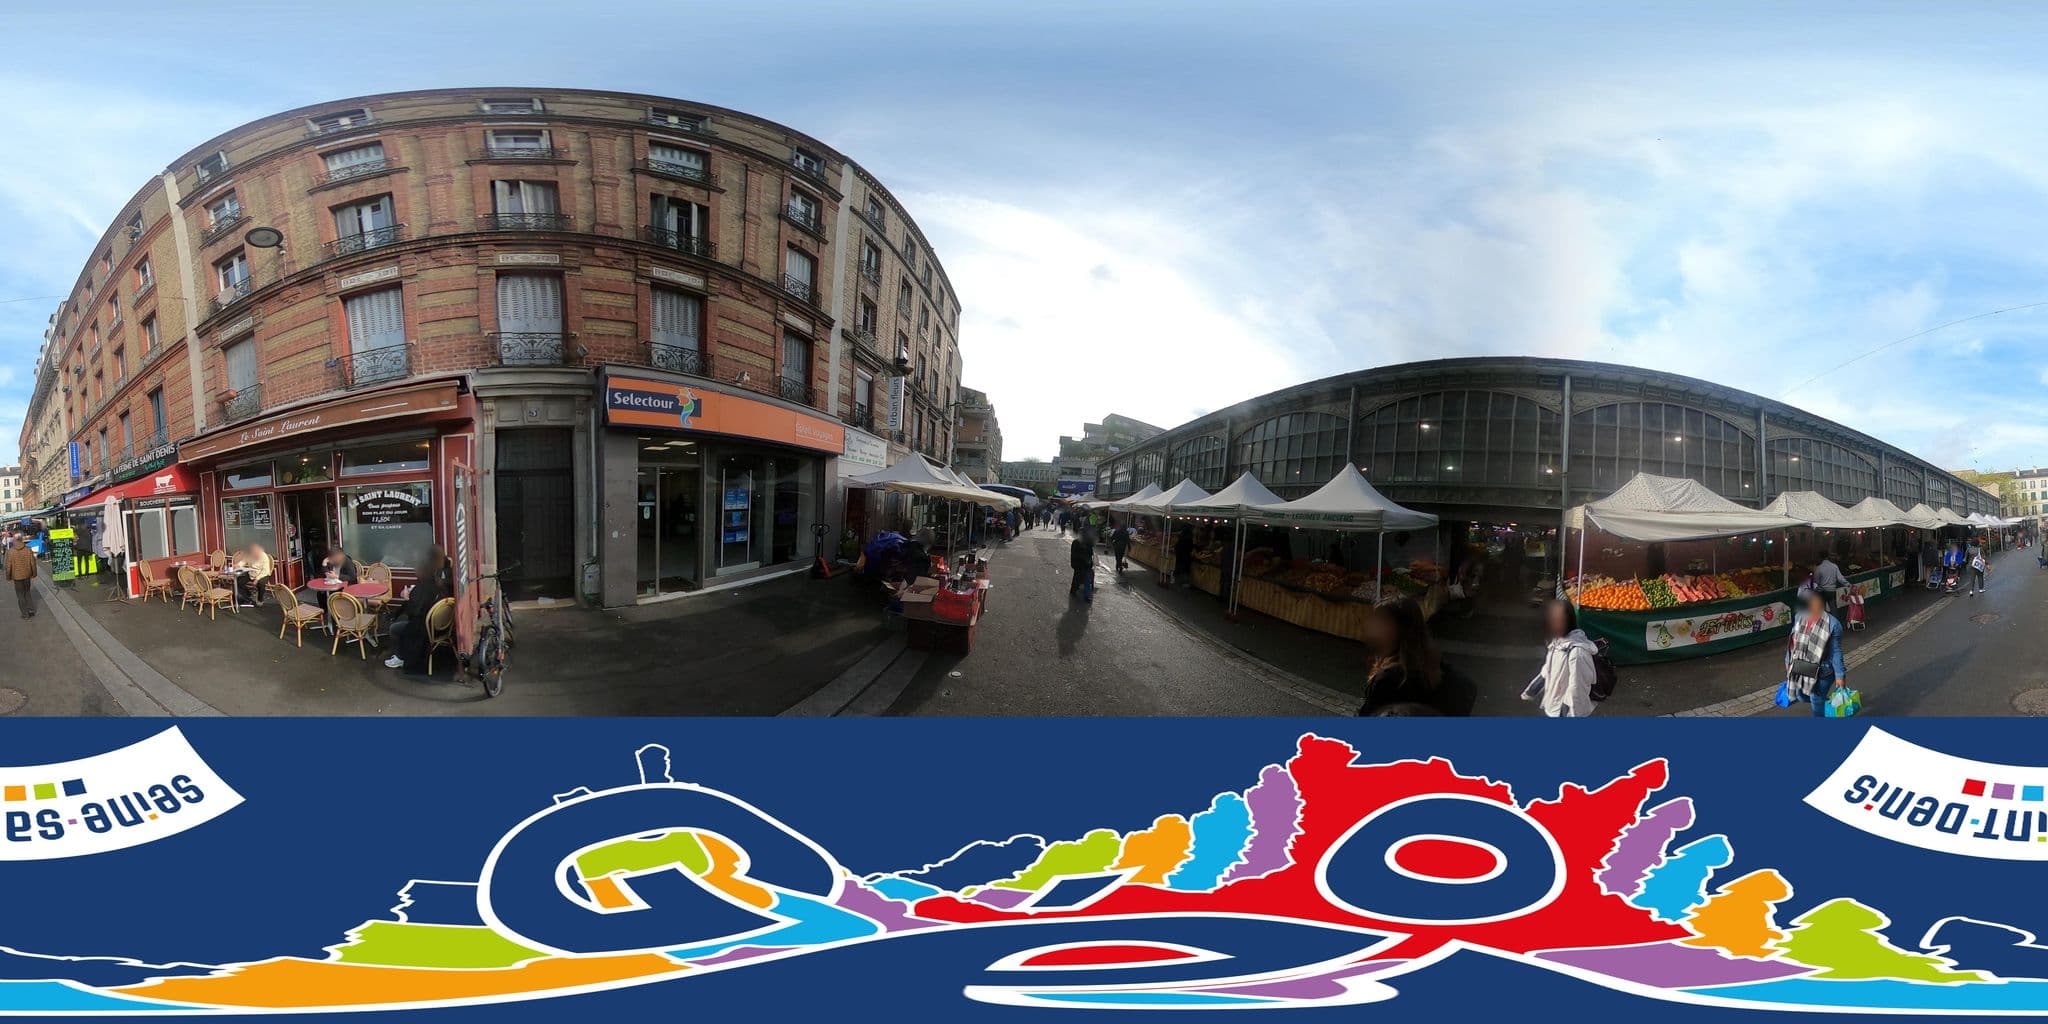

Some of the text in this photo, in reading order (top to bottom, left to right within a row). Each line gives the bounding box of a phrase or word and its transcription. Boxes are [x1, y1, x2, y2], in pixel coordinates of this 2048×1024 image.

[614, 392, 674, 409] Selectour
[889, 401, 898, 427] Urban
[239, 415, 320, 443] Le Saint Laurent
[140, 452, 156, 465] SAINT
[155, 444, 176, 459] DENIS
[359, 490, 382, 503] SAINT
[384, 490, 421, 506] LAURENT
